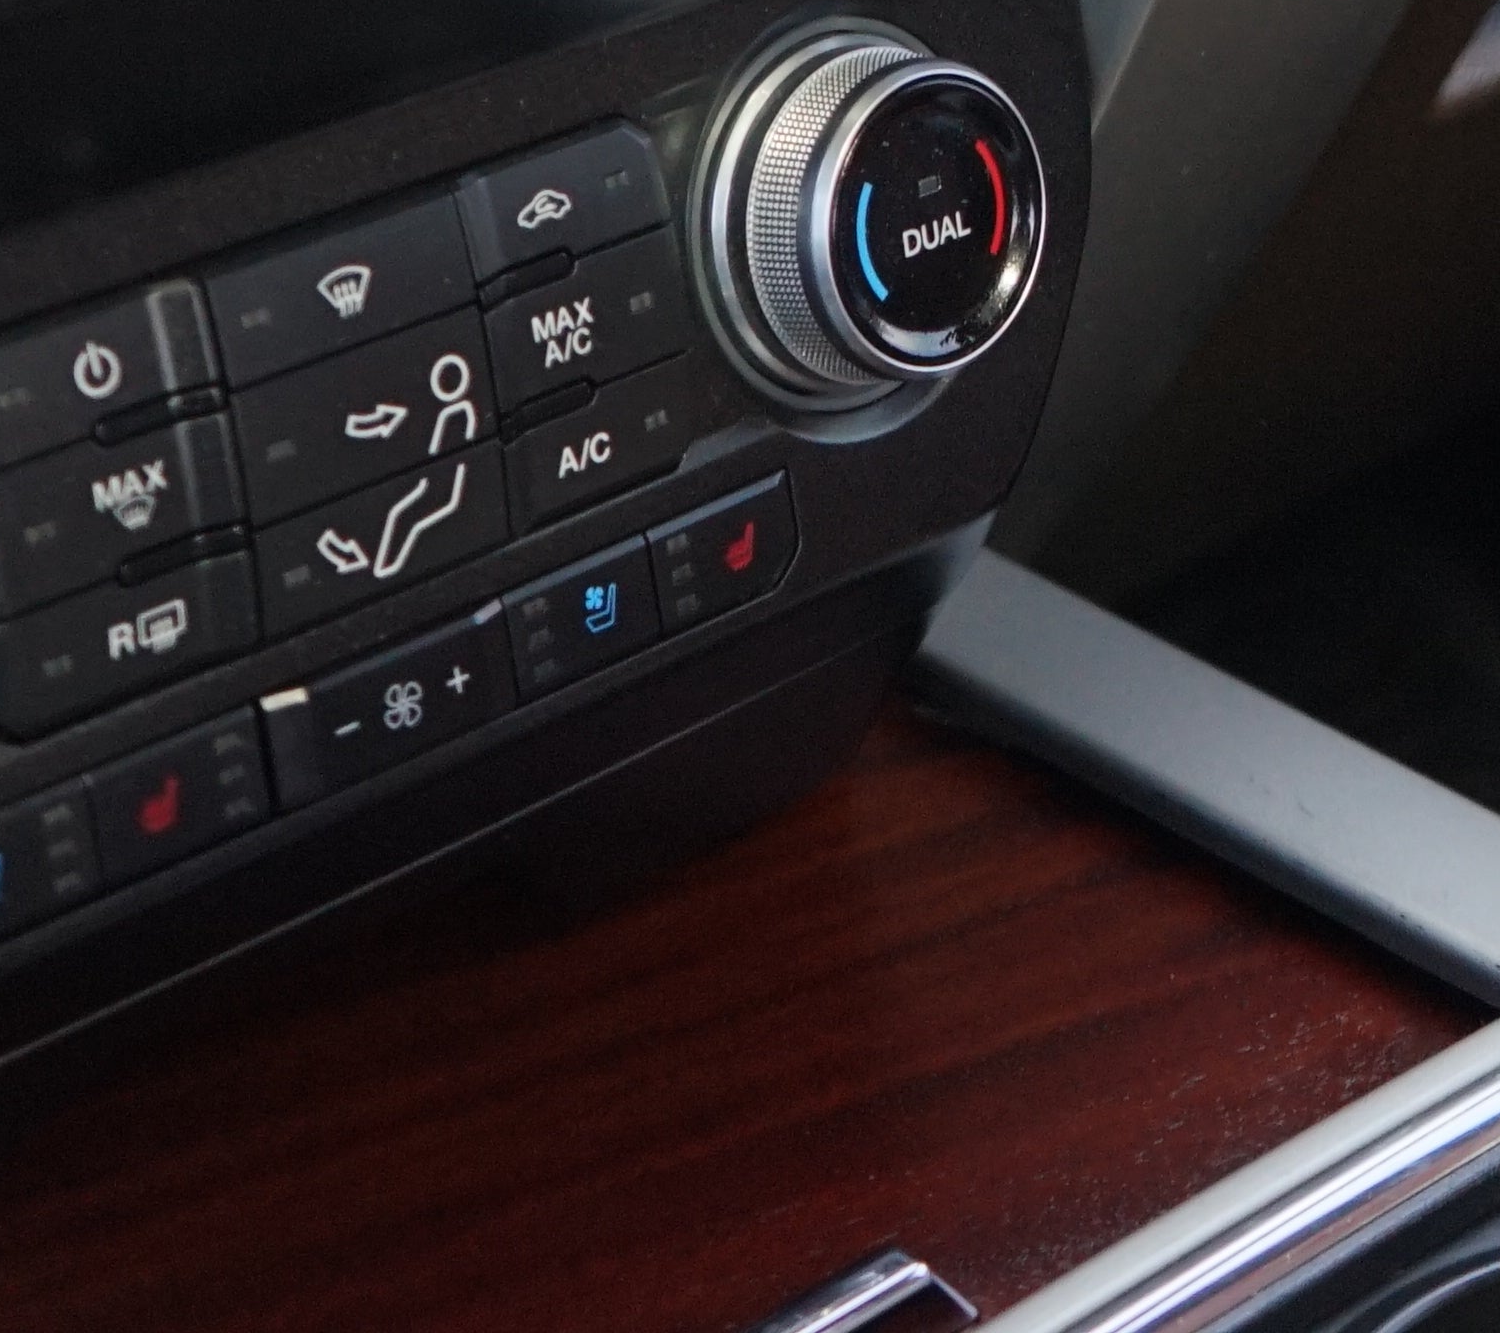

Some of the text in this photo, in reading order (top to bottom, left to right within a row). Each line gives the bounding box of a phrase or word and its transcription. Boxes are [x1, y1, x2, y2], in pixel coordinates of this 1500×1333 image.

[902, 210, 972, 258] DUAL
[530, 297, 596, 344] MAX
[544, 328, 592, 369] A/C
[558, 431, 613, 478] A/C
[91, 459, 168, 511] MAX
